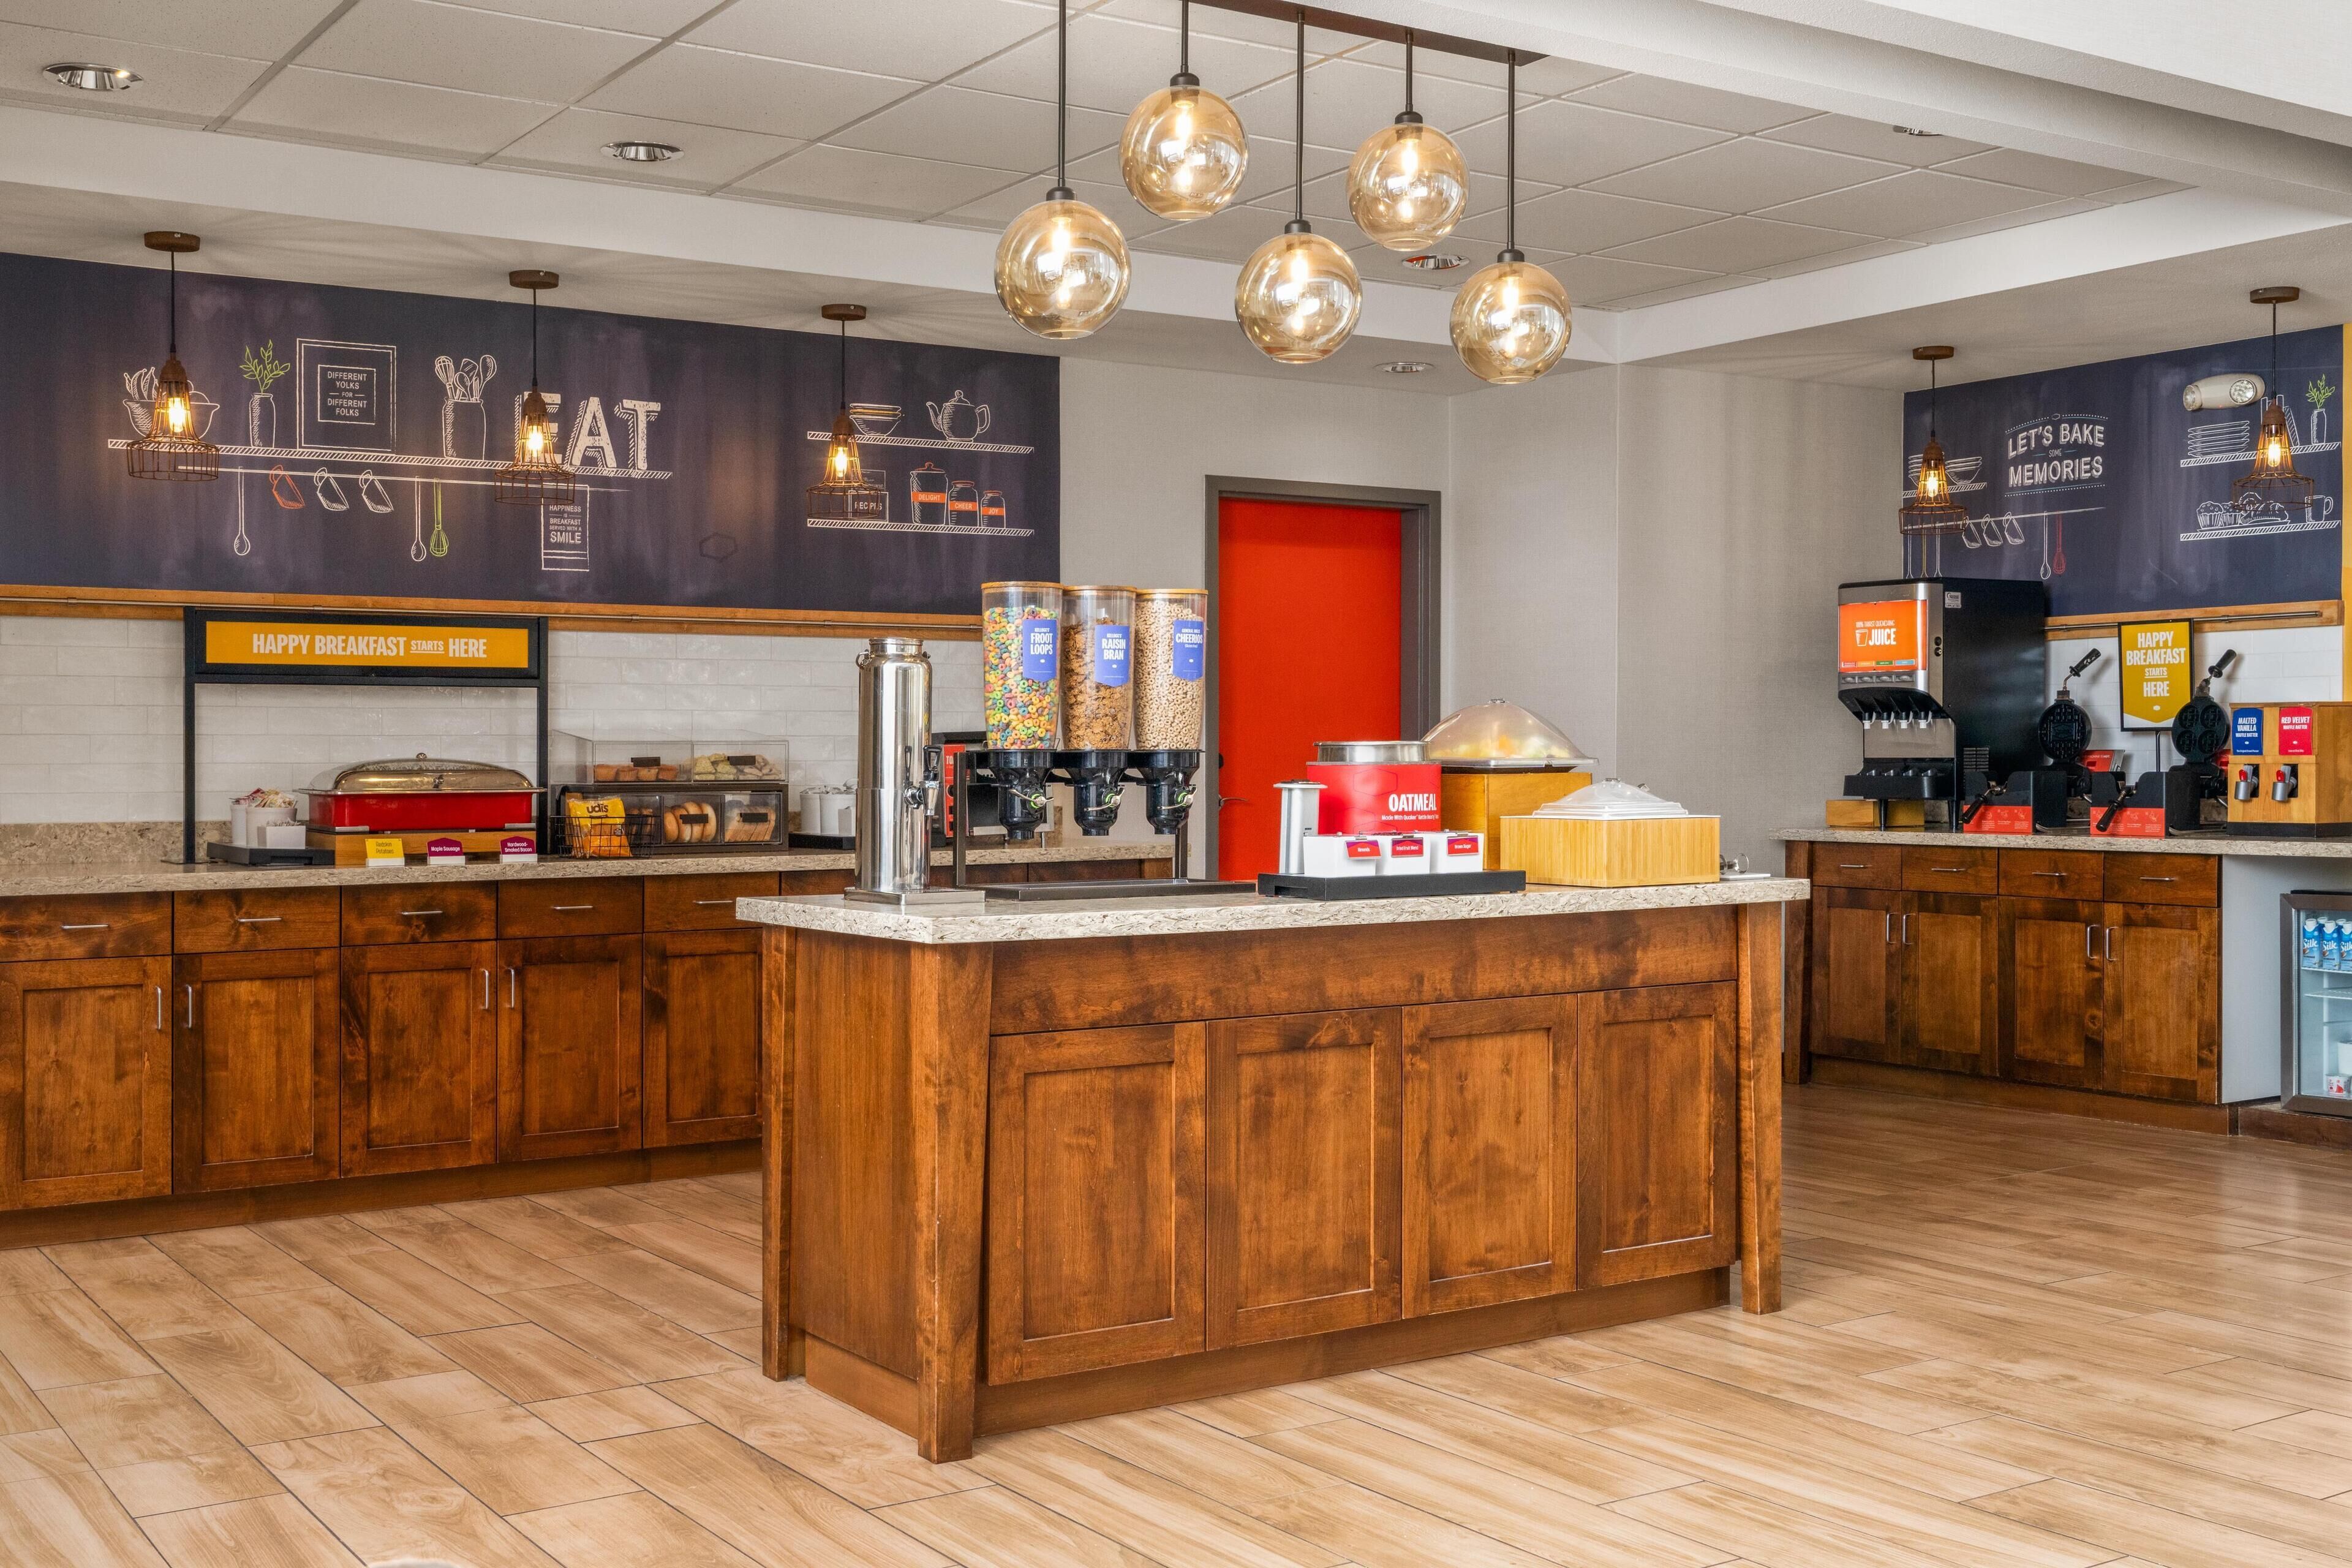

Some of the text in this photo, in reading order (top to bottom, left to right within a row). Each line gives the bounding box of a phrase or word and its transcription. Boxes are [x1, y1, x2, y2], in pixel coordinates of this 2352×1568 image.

[328, 371, 367, 381] DIFFERENT
[336, 381, 360, 390] YOLKS
[328, 398, 367, 408] DIFFERENT
[336, 408, 359, 417] FOLKS
[519, 391, 661, 470] EAT
[2008, 423, 2105, 459] LET'S BAKE
[2048, 448, 2062, 458] SOME
[2009, 456, 2103, 488] MEMORIES
[551, 532, 582, 544] SMILE
[1030, 633, 1053, 644] FROOT
[1176, 633, 1203, 644] CHEERIOS
[1869, 628, 1897, 646] JUICE
[2138, 631, 2174, 648] HAPPY
[252, 633, 487, 658] HAPPY BREAKFAST STARTS HERE
[1102, 638, 1126, 649] RAISIN
[1030, 644, 1053, 655] LOOPS
[1104, 649, 1124, 660] BRAN
[2126, 647, 2186, 666] BREAKFAST
[2144, 667, 2168, 677] STARTS
[2143, 681, 2169, 697] HERE
[1388, 793, 1438, 812] OATMEAL
[2303, 938, 2318, 949] Silk
[2323, 940, 2338, 952] Silk
